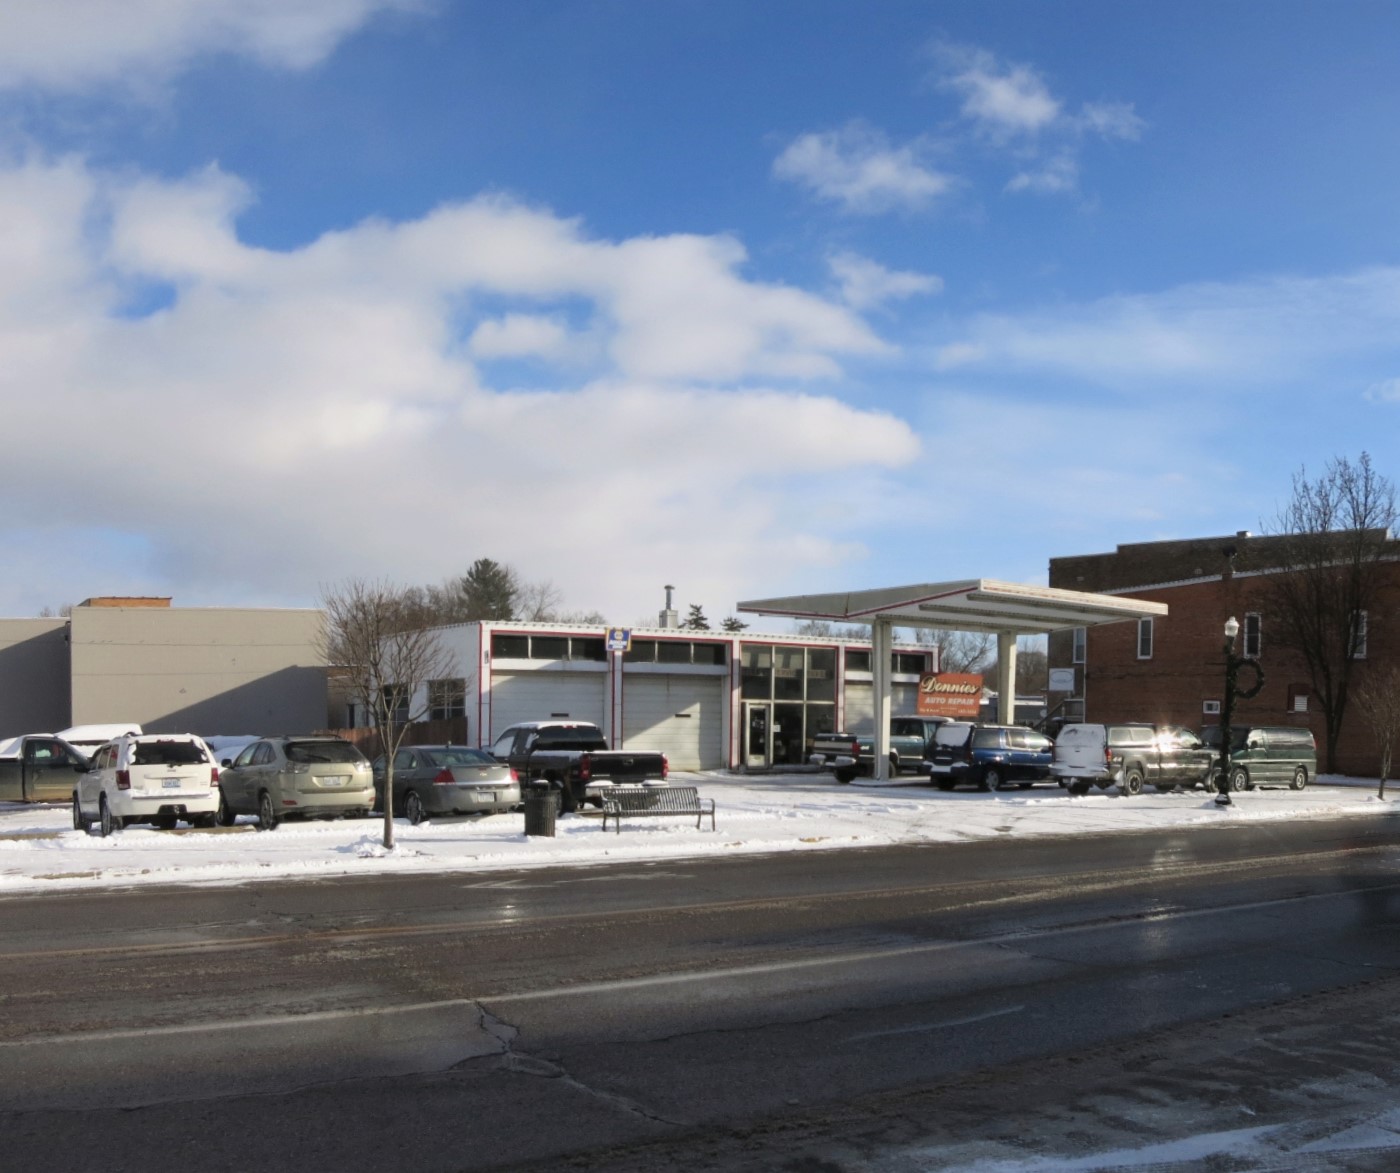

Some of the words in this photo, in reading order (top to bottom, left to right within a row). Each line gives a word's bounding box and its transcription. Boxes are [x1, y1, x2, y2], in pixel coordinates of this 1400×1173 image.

[921, 675, 980, 693] Donnies
[925, 696, 946, 704] AUTO
[947, 697, 975, 705] REPAIR
